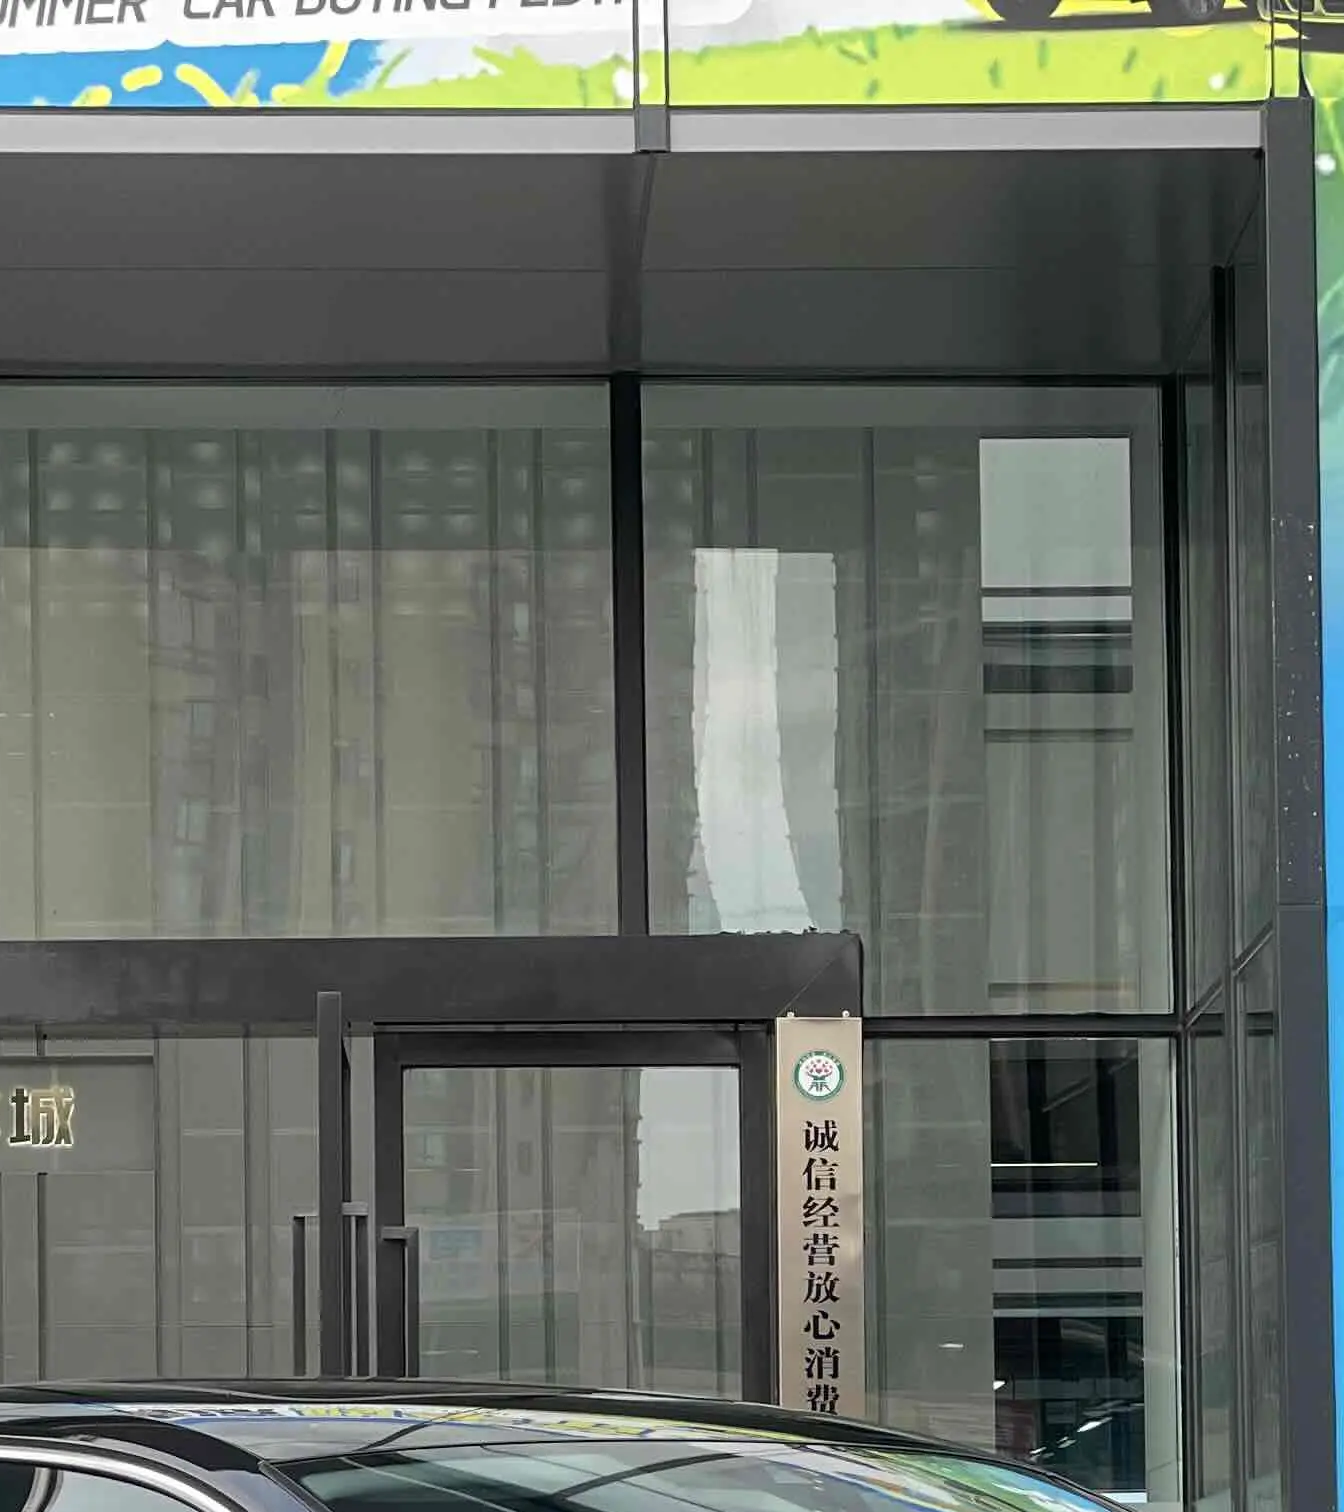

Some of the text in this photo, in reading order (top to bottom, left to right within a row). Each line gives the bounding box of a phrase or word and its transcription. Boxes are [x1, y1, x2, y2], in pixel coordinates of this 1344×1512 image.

[802, 1119, 841, 1414] 诚信经营放心消费
